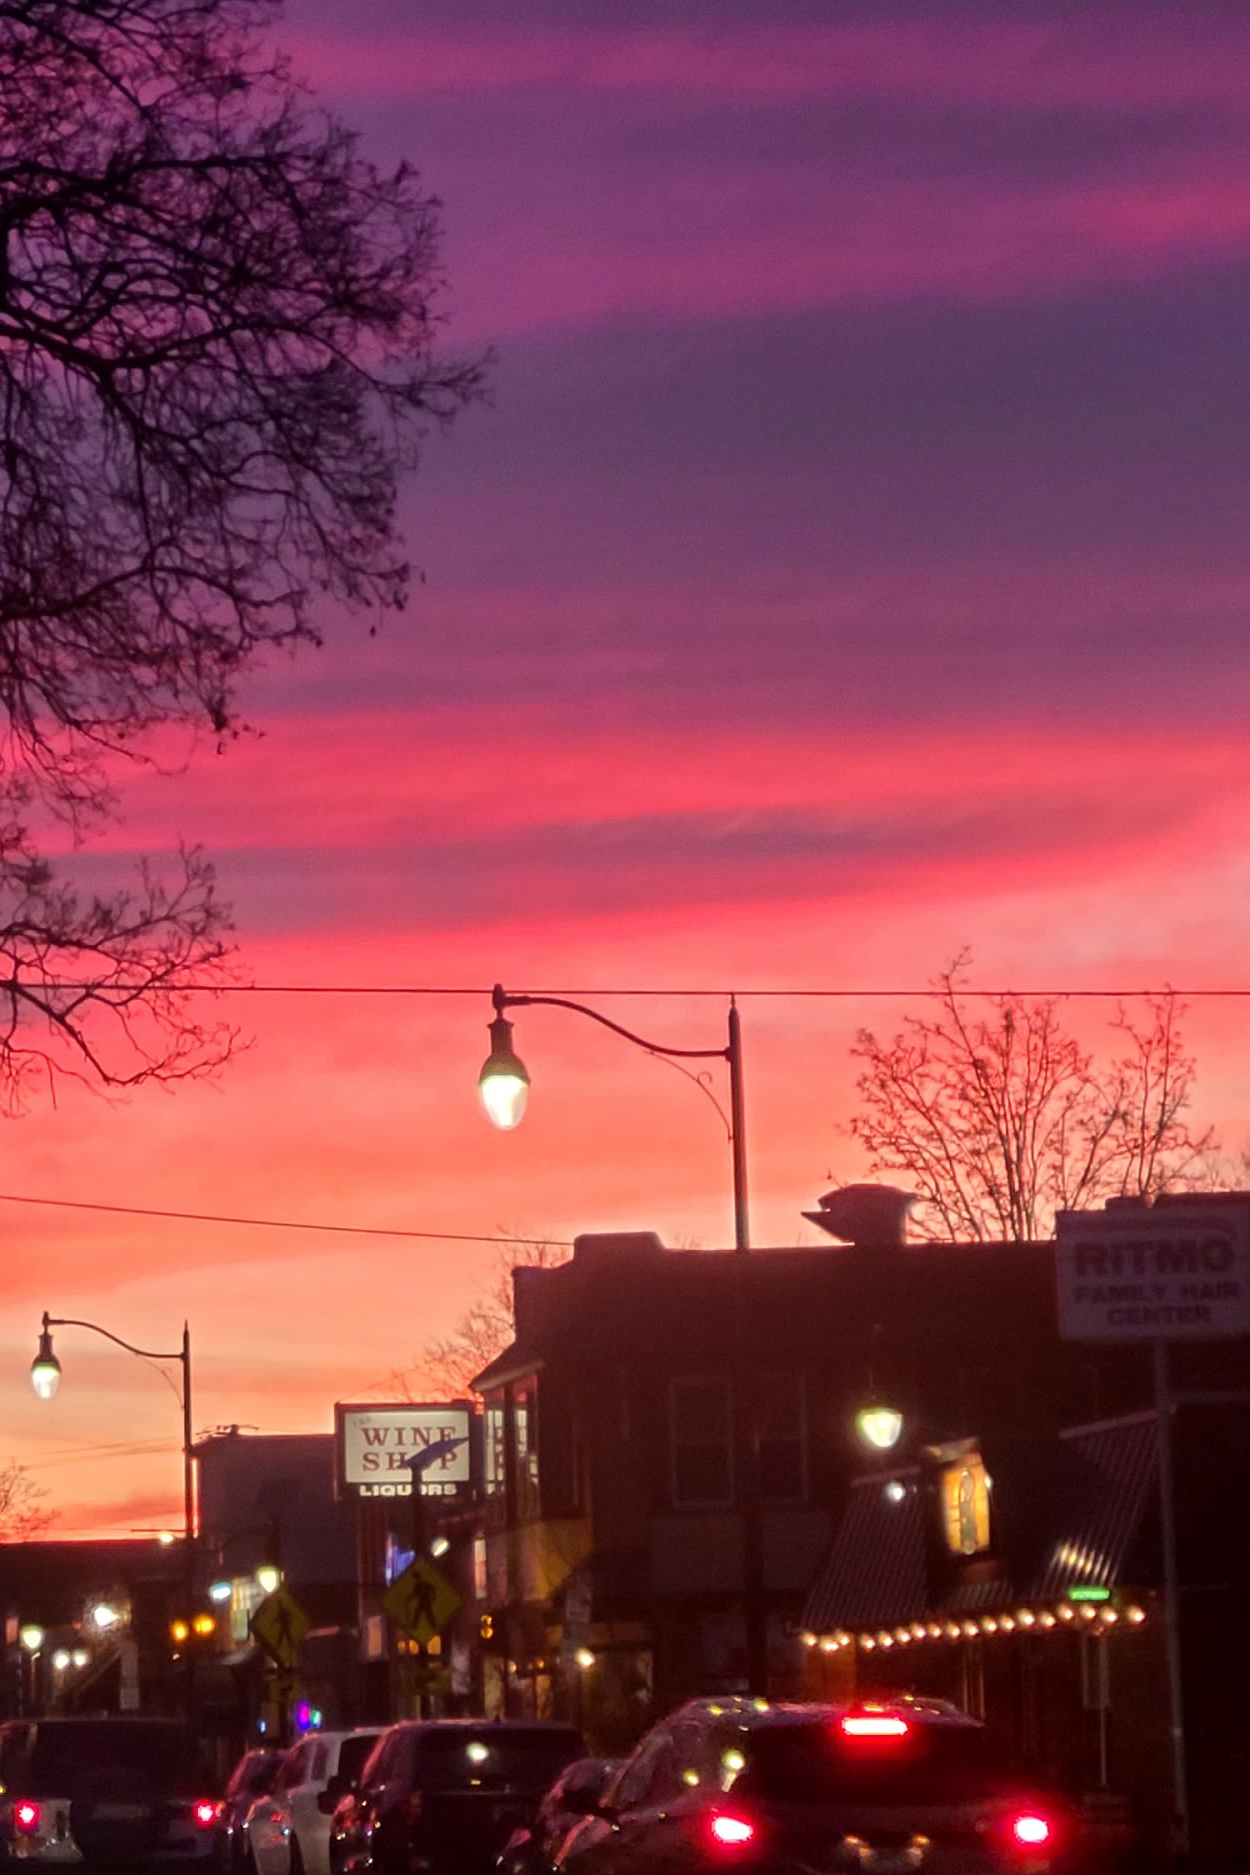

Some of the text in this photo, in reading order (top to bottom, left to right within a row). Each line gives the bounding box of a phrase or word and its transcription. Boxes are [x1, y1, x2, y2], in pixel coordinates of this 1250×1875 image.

[1074, 1238, 1235, 1275] RITMO
[1074, 1281, 1240, 1303] FAMILY HAIR
[1106, 1305, 1211, 1325] CENTER
[362, 1451, 458, 1472] SHP
